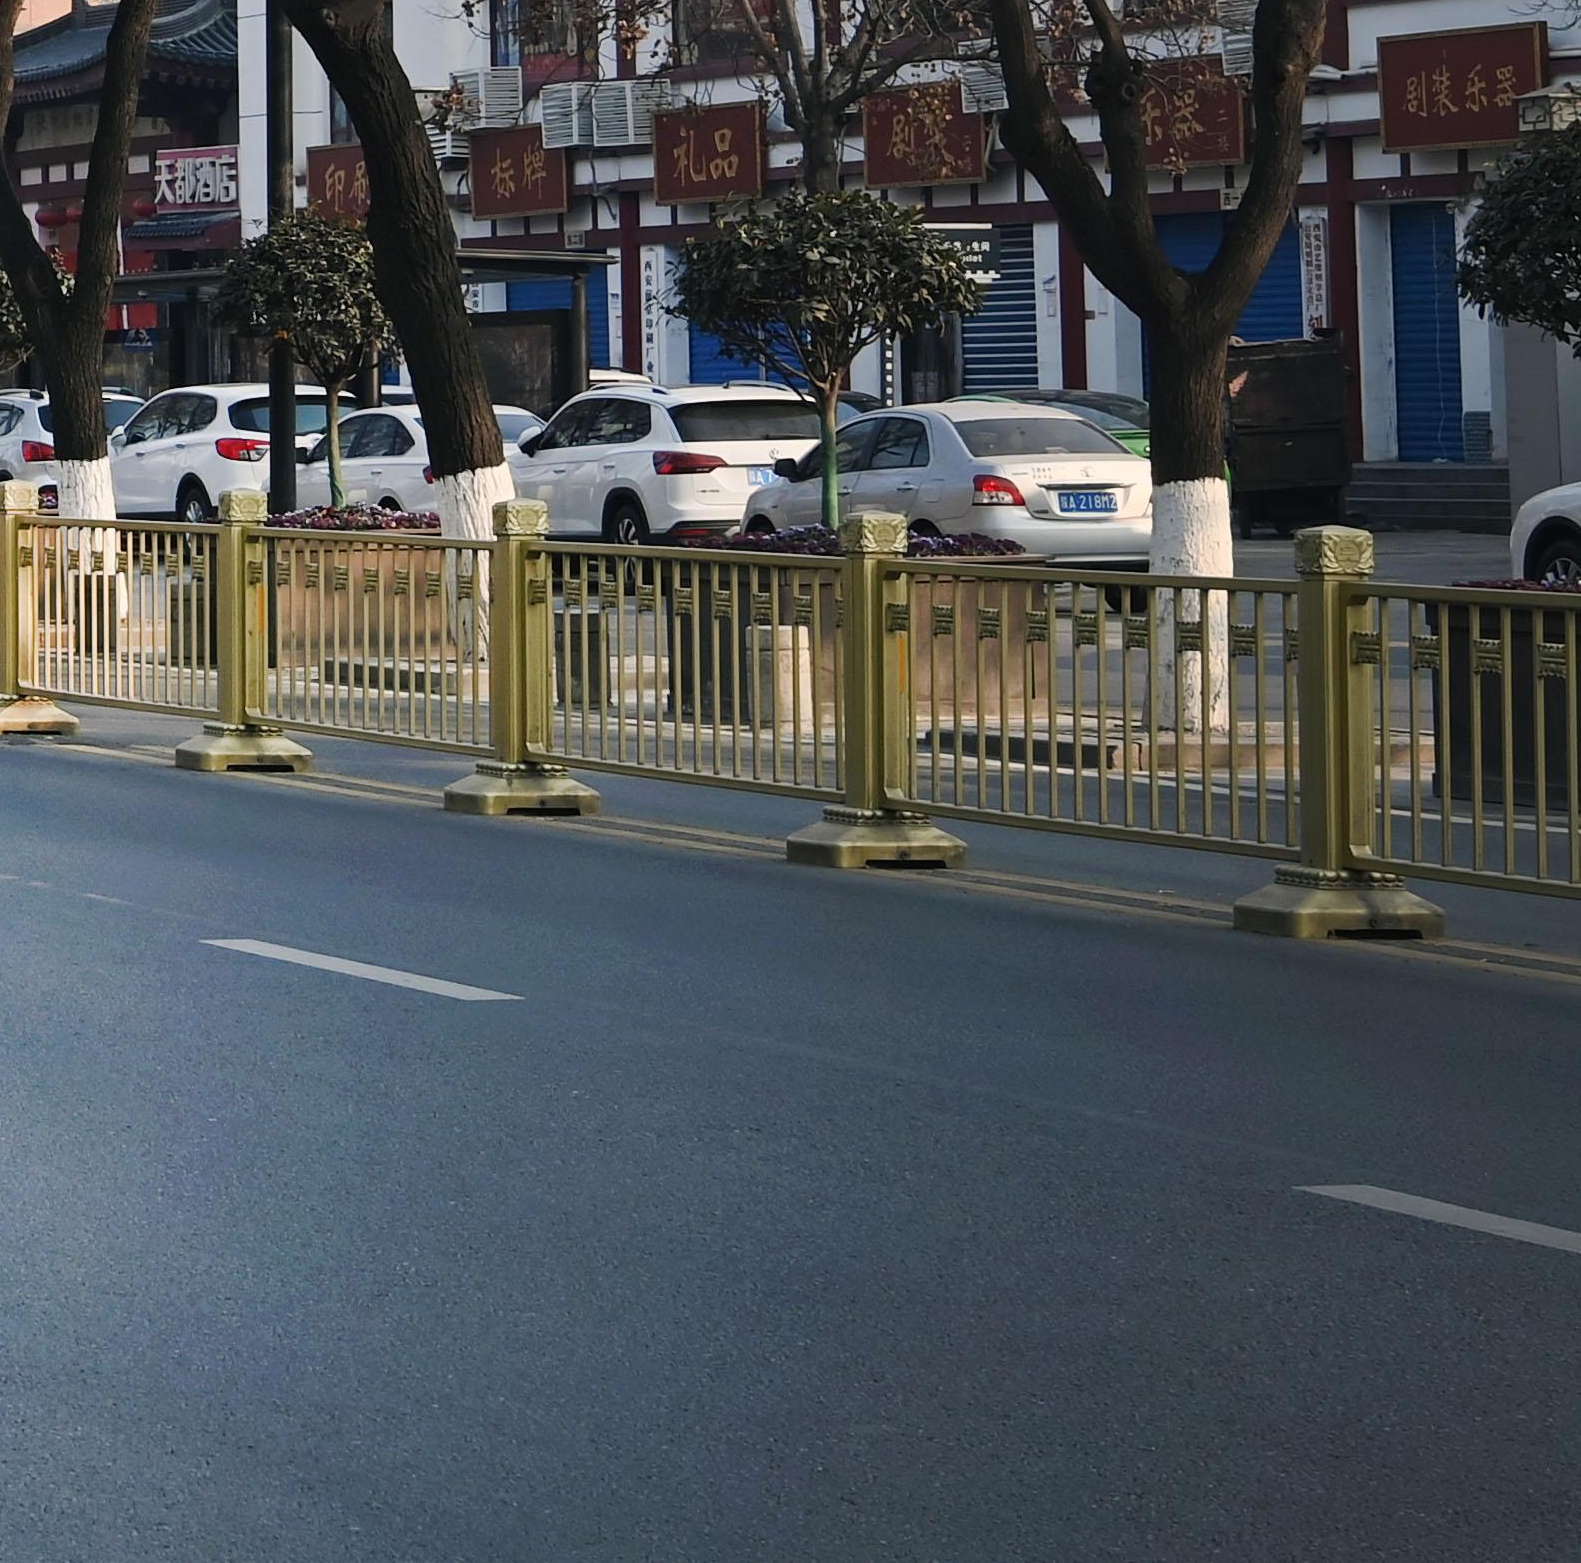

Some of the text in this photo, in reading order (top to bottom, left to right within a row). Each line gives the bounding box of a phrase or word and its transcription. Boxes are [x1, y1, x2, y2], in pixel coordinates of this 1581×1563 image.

[154, 154, 237, 204] 天都酒店
[491, 142, 547, 200] 标牌
[672, 124, 739, 187] 礼品
